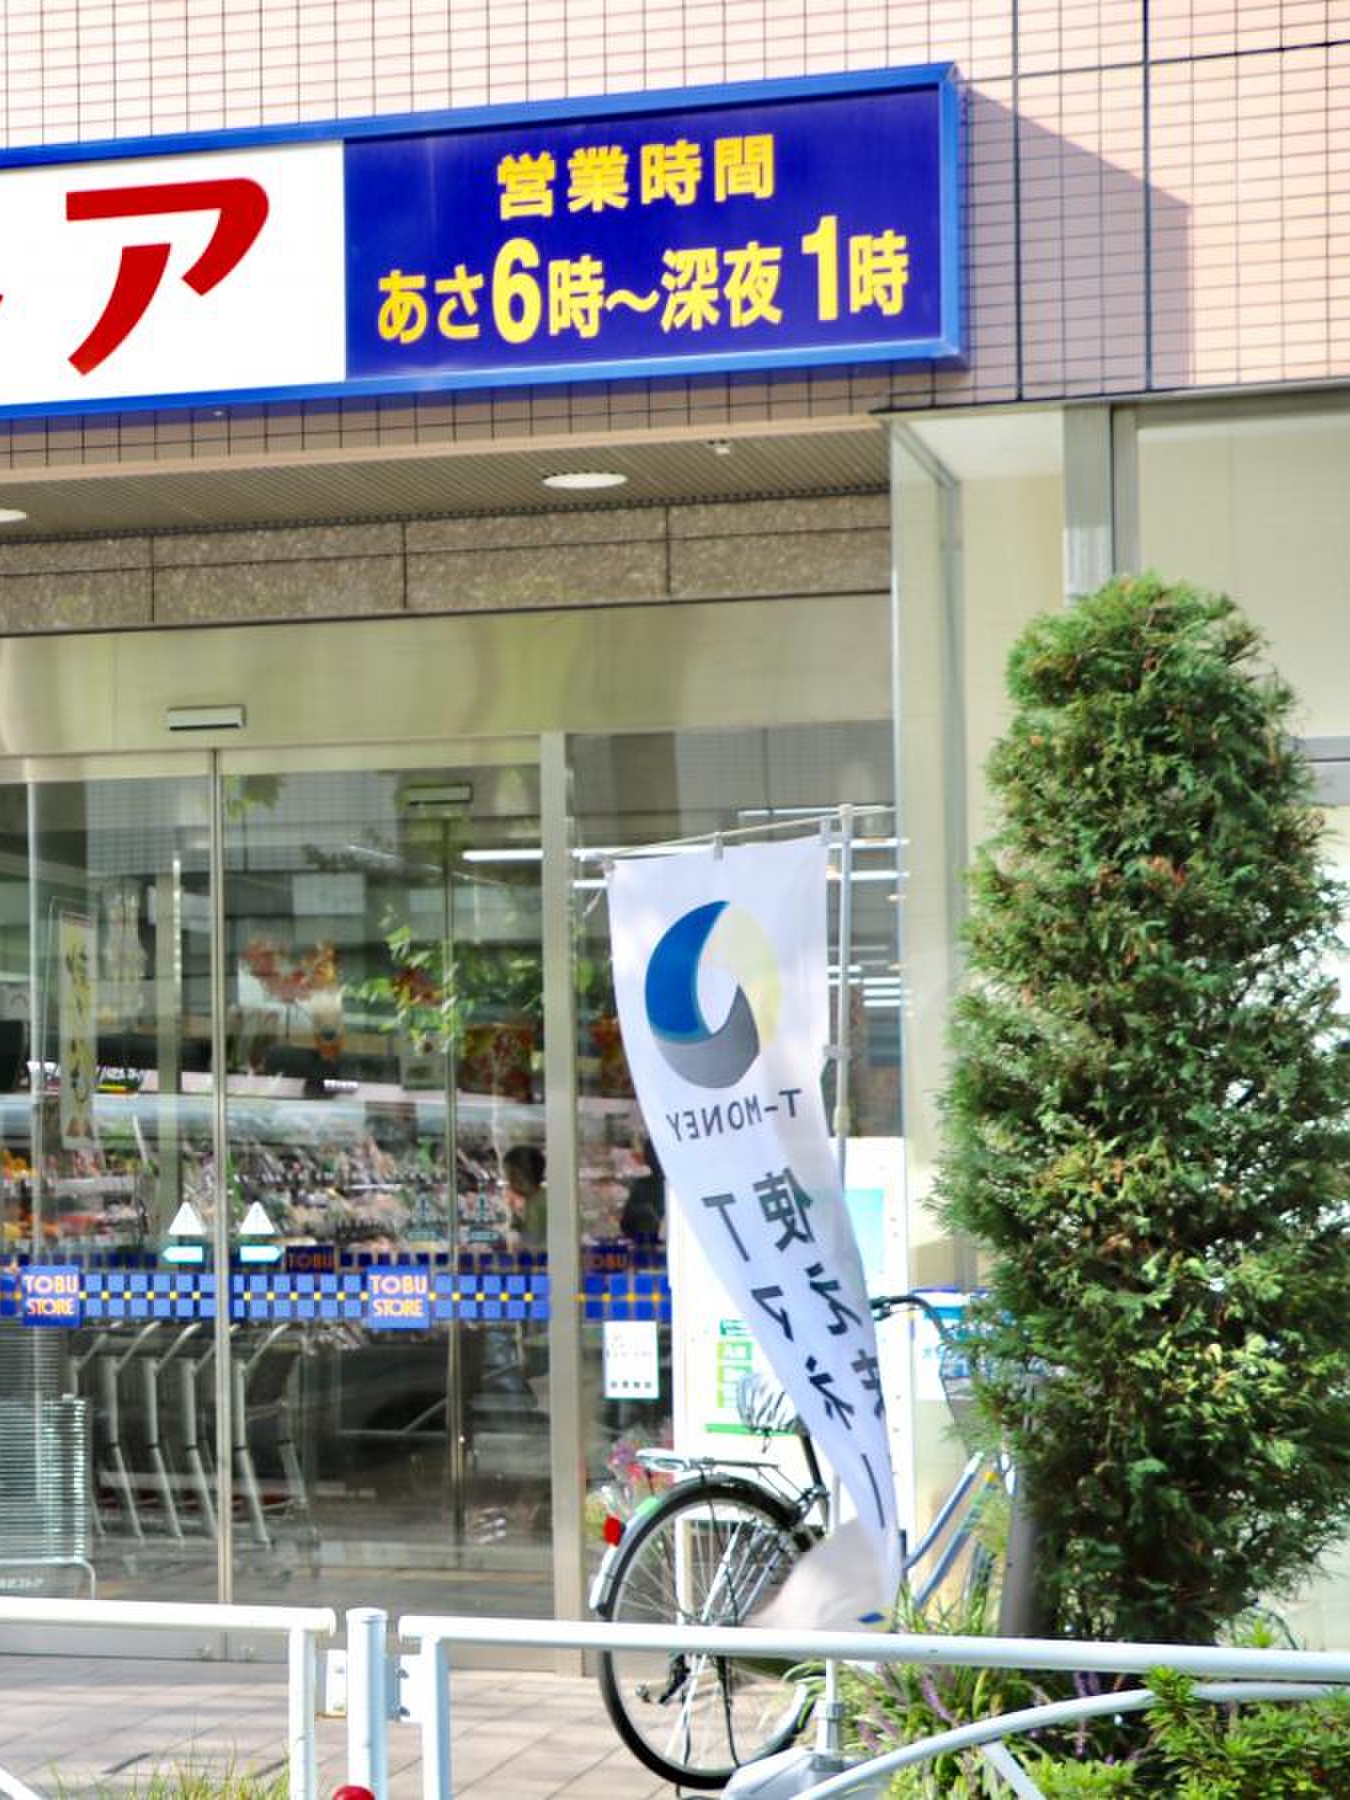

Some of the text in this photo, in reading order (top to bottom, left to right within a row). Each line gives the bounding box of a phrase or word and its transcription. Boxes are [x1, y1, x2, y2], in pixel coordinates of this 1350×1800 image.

[498, 133, 774, 221] 営業時間
[24, 1275, 79, 1295] TOBU
[368, 1274, 428, 1295] TOBU
[26, 1297, 75, 1315] STORE
[372, 1298, 424, 1318] STORE
